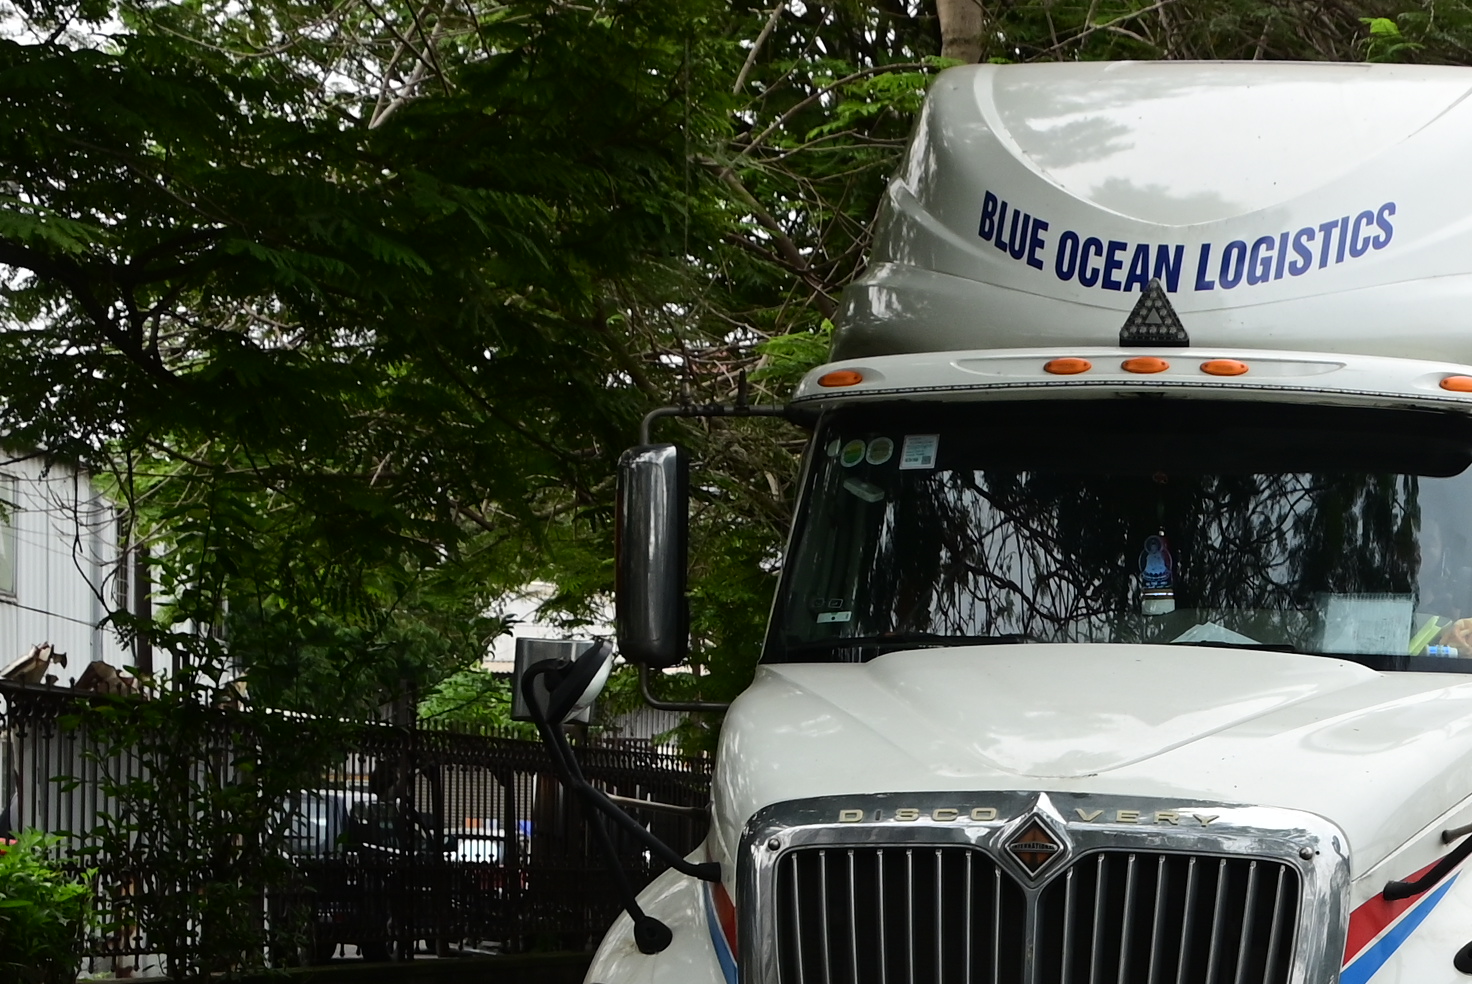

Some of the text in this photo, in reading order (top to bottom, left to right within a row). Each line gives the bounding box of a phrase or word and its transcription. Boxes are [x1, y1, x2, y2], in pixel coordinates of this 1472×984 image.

[978, 190, 1397, 293] BLUE OCEAN LOGISTICS
